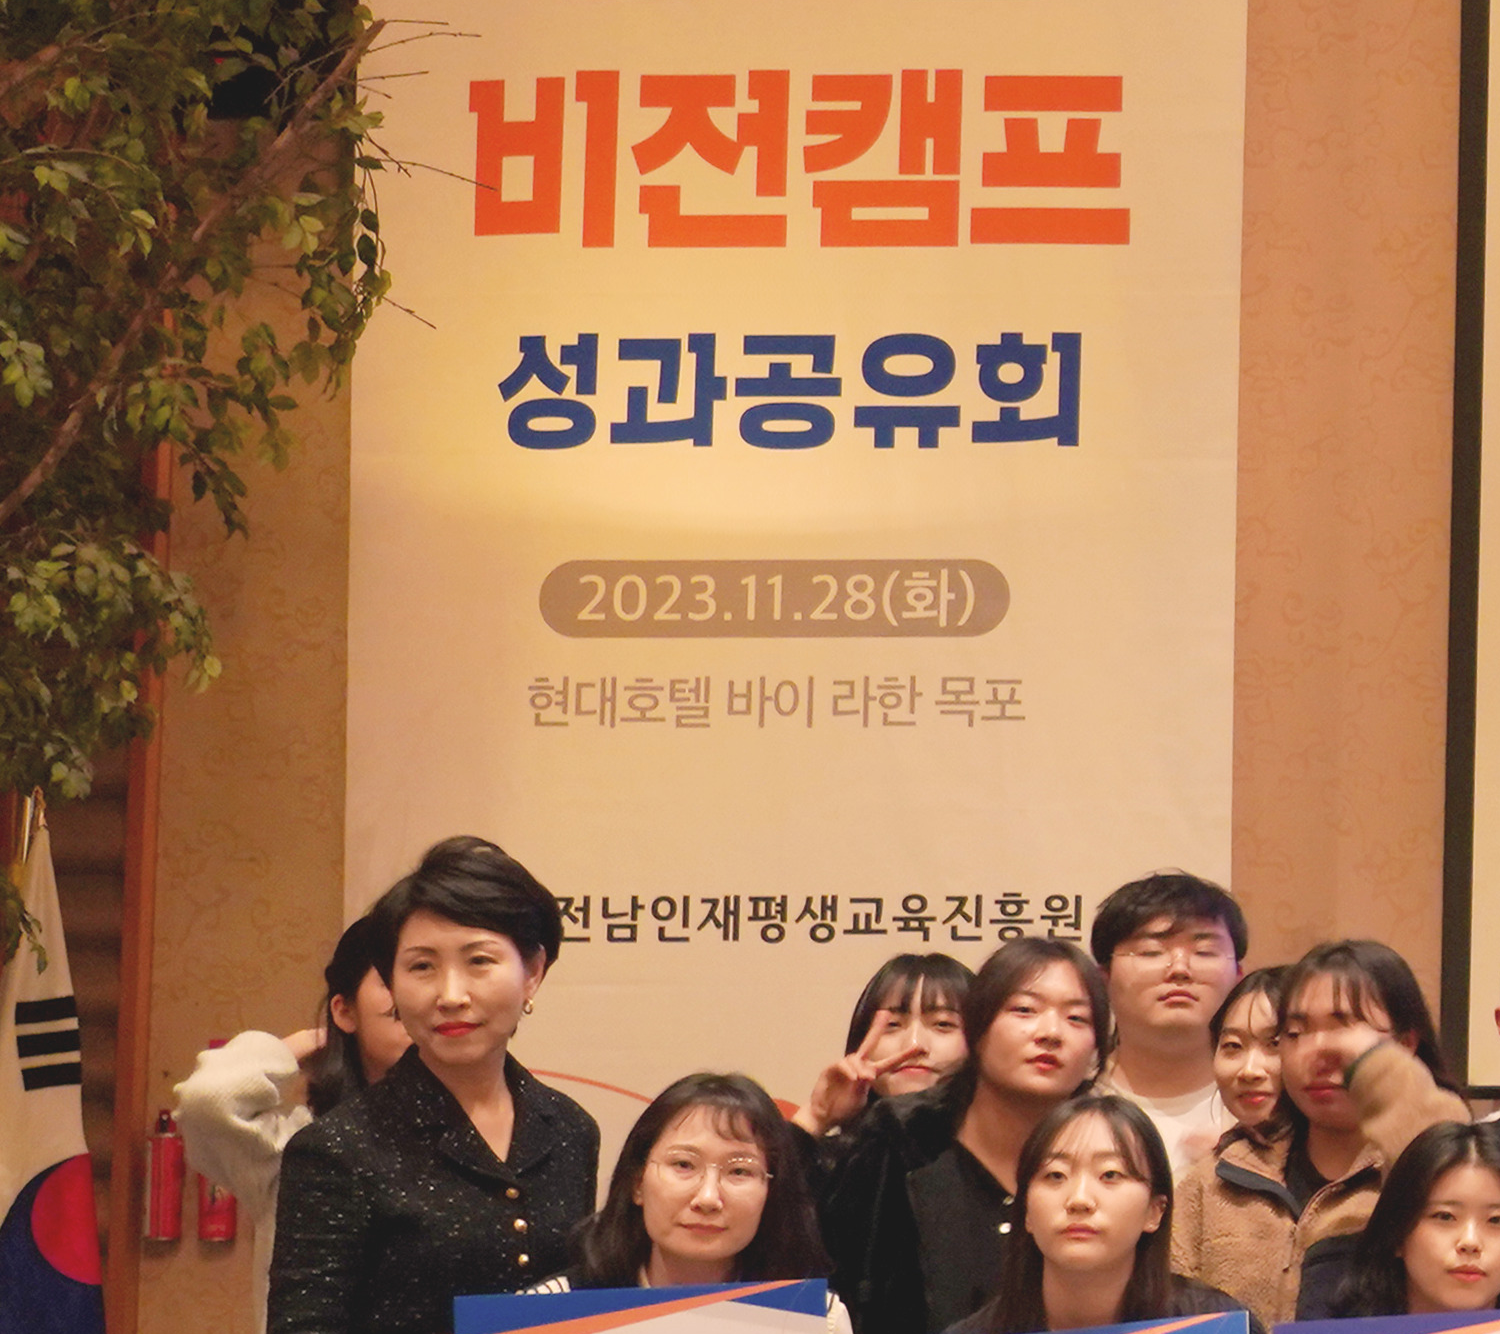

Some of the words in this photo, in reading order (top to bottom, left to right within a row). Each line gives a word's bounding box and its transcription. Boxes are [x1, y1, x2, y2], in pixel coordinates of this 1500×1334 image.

[469, 69, 1131, 249] 비전캠프
[498, 332, 1082, 450] 성과공유회
[578, 568, 975, 627] 2023.11.28(화)
[528, 676, 710, 728] 현대호텔
[727, 676, 814, 728] 바이
[832, 675, 923, 728] 라한
[935, 677, 1025, 727] 목포
